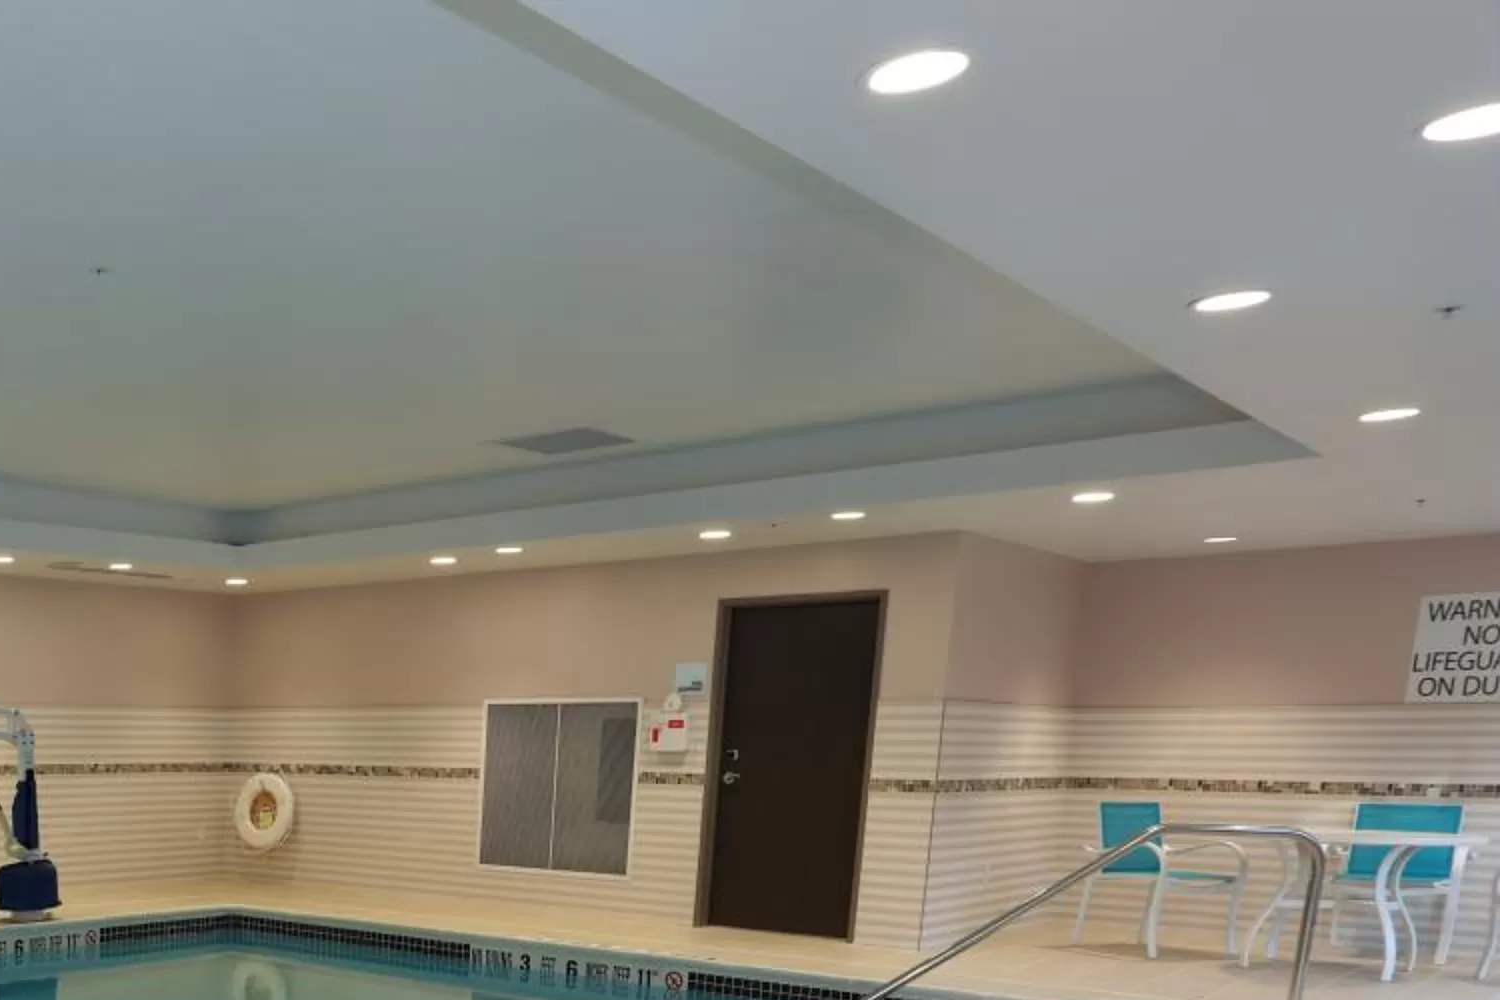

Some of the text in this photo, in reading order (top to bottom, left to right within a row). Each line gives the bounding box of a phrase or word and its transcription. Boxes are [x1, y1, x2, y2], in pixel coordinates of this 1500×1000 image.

[1463, 624, 1500, 646] NO
[1417, 675, 1500, 697] ON DU
